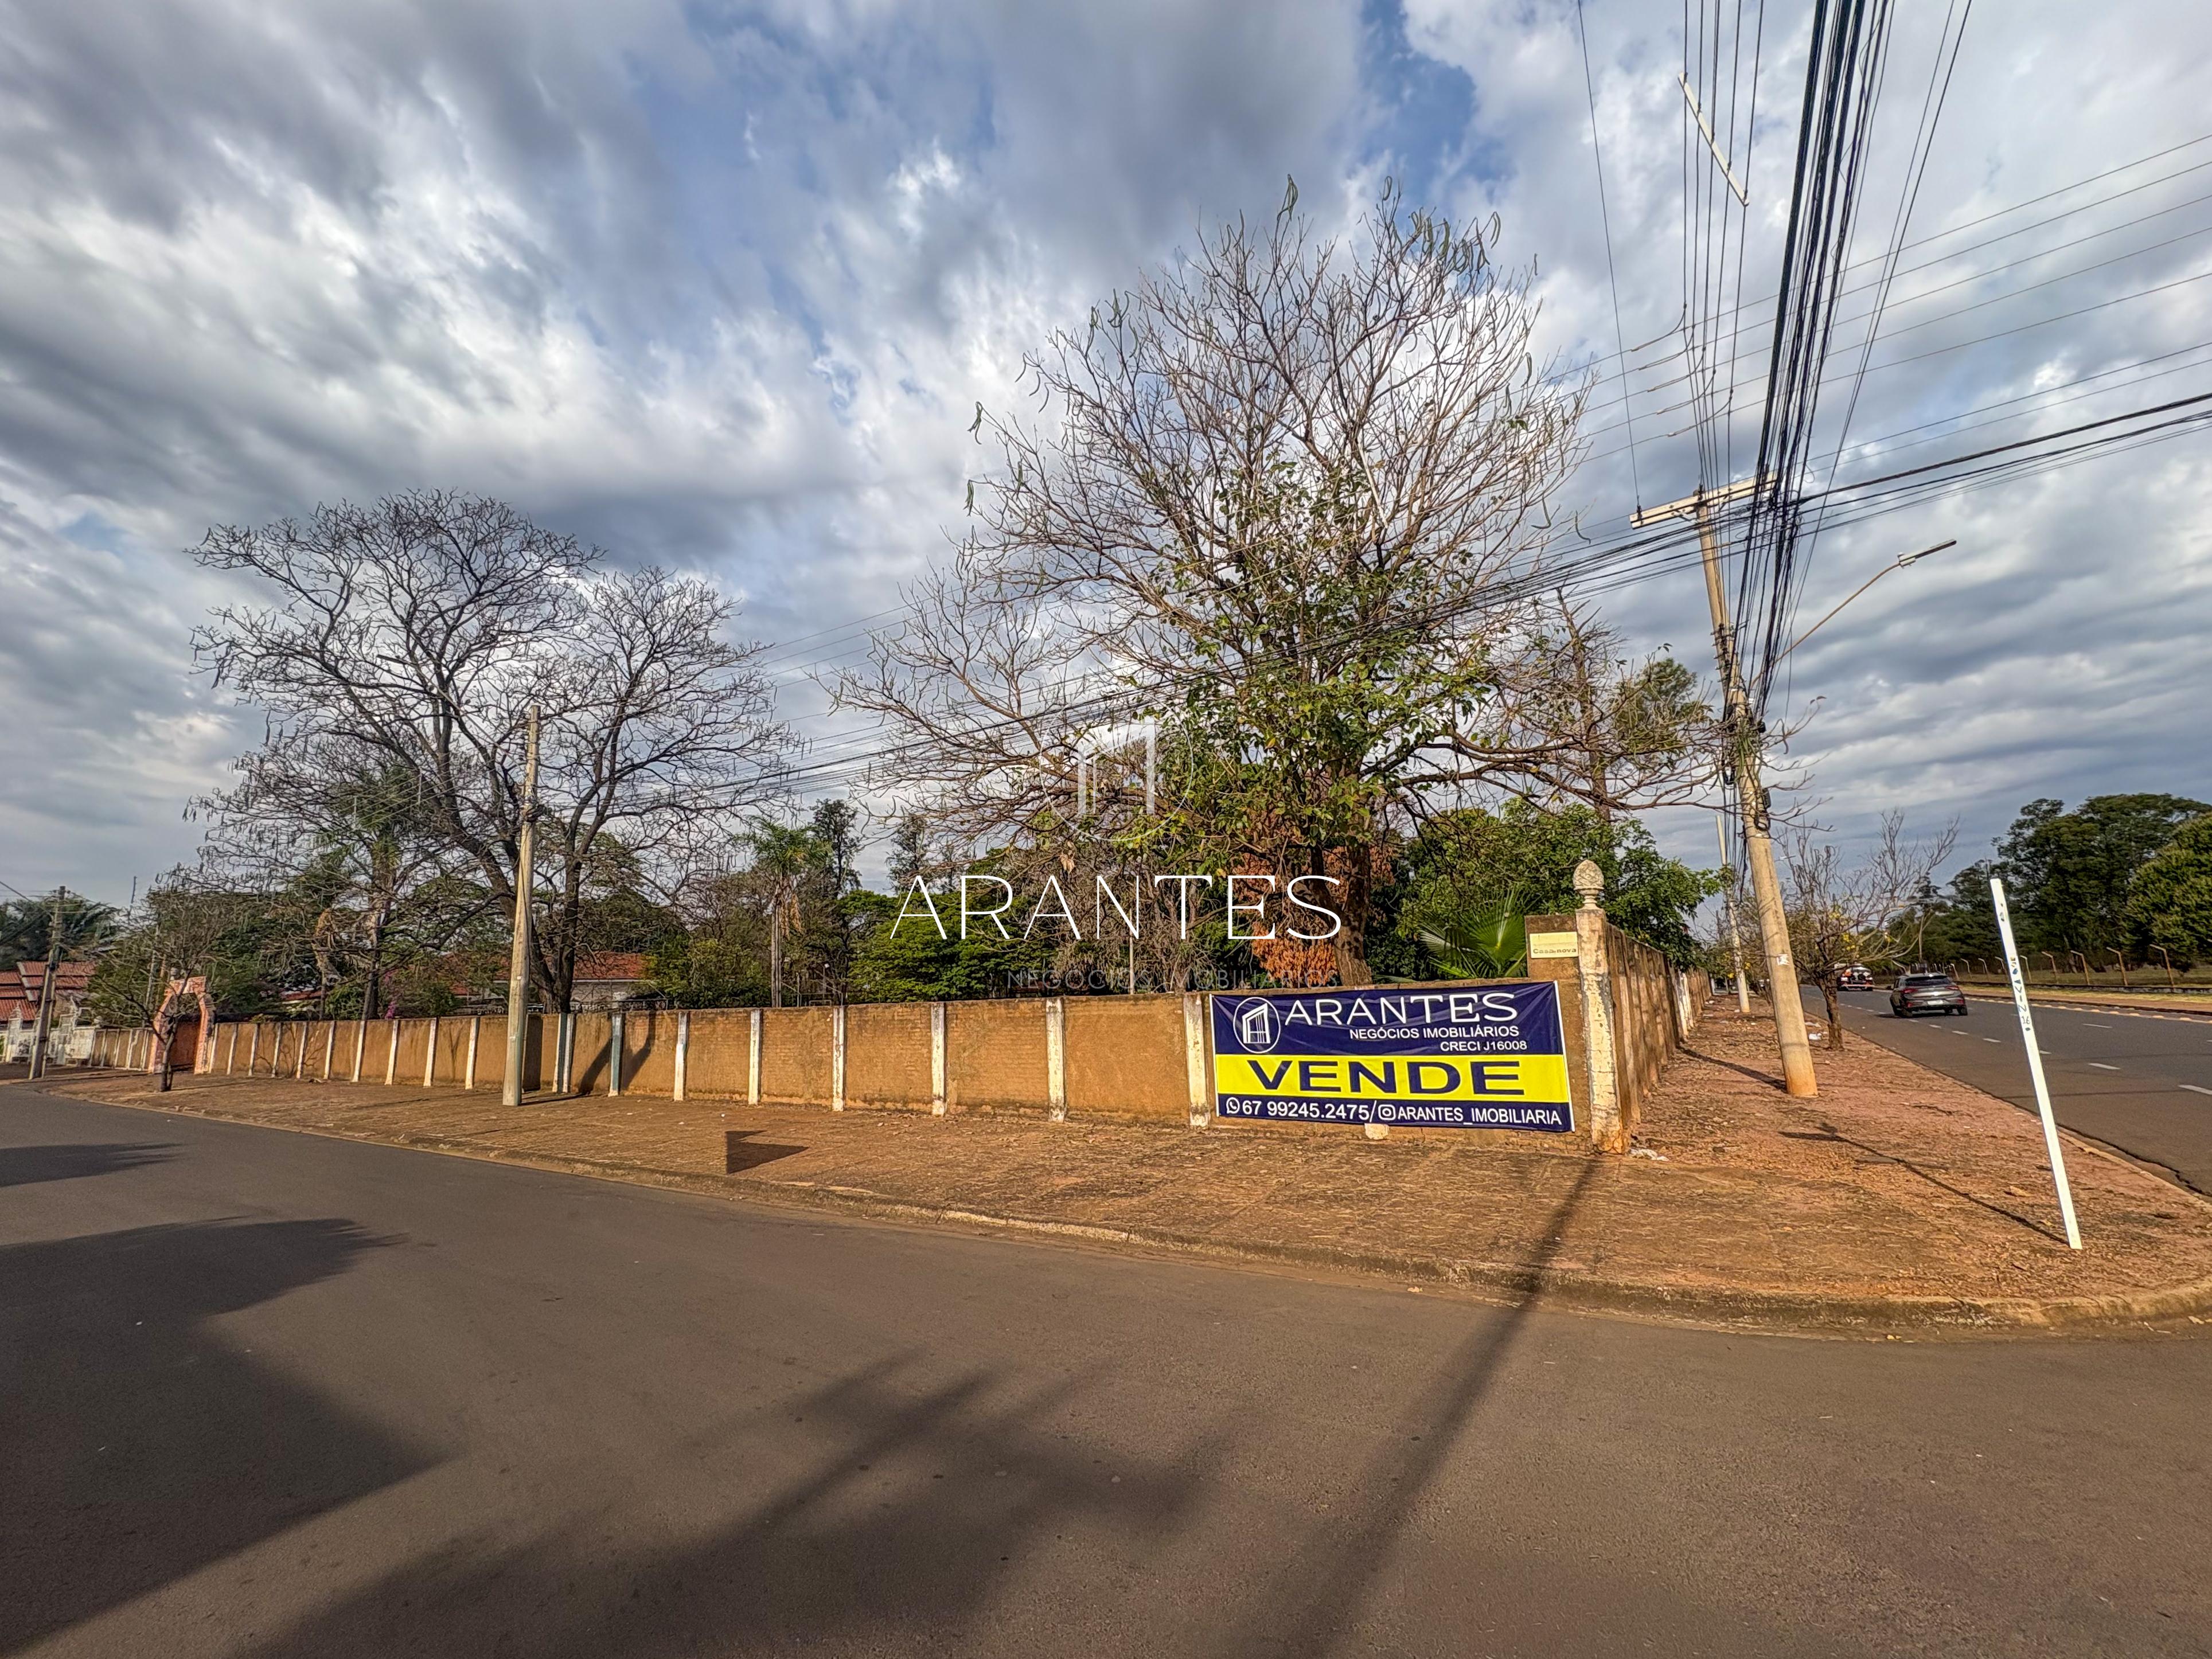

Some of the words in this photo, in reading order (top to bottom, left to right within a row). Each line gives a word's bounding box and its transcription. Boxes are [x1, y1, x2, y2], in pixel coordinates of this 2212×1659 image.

[1285, 993, 1518, 1025] ARANTES
[1349, 1026, 1419, 1039] NEGÓCIOS
[1423, 1025, 1520, 1039] IMOBILIÁRIOS
[1440, 1041, 1481, 1052] CRECI
[1483, 1040, 1528, 1051] J16008
[1247, 1060, 1524, 1095] VENDE
[1242, 1100, 1262, 1115] 67
